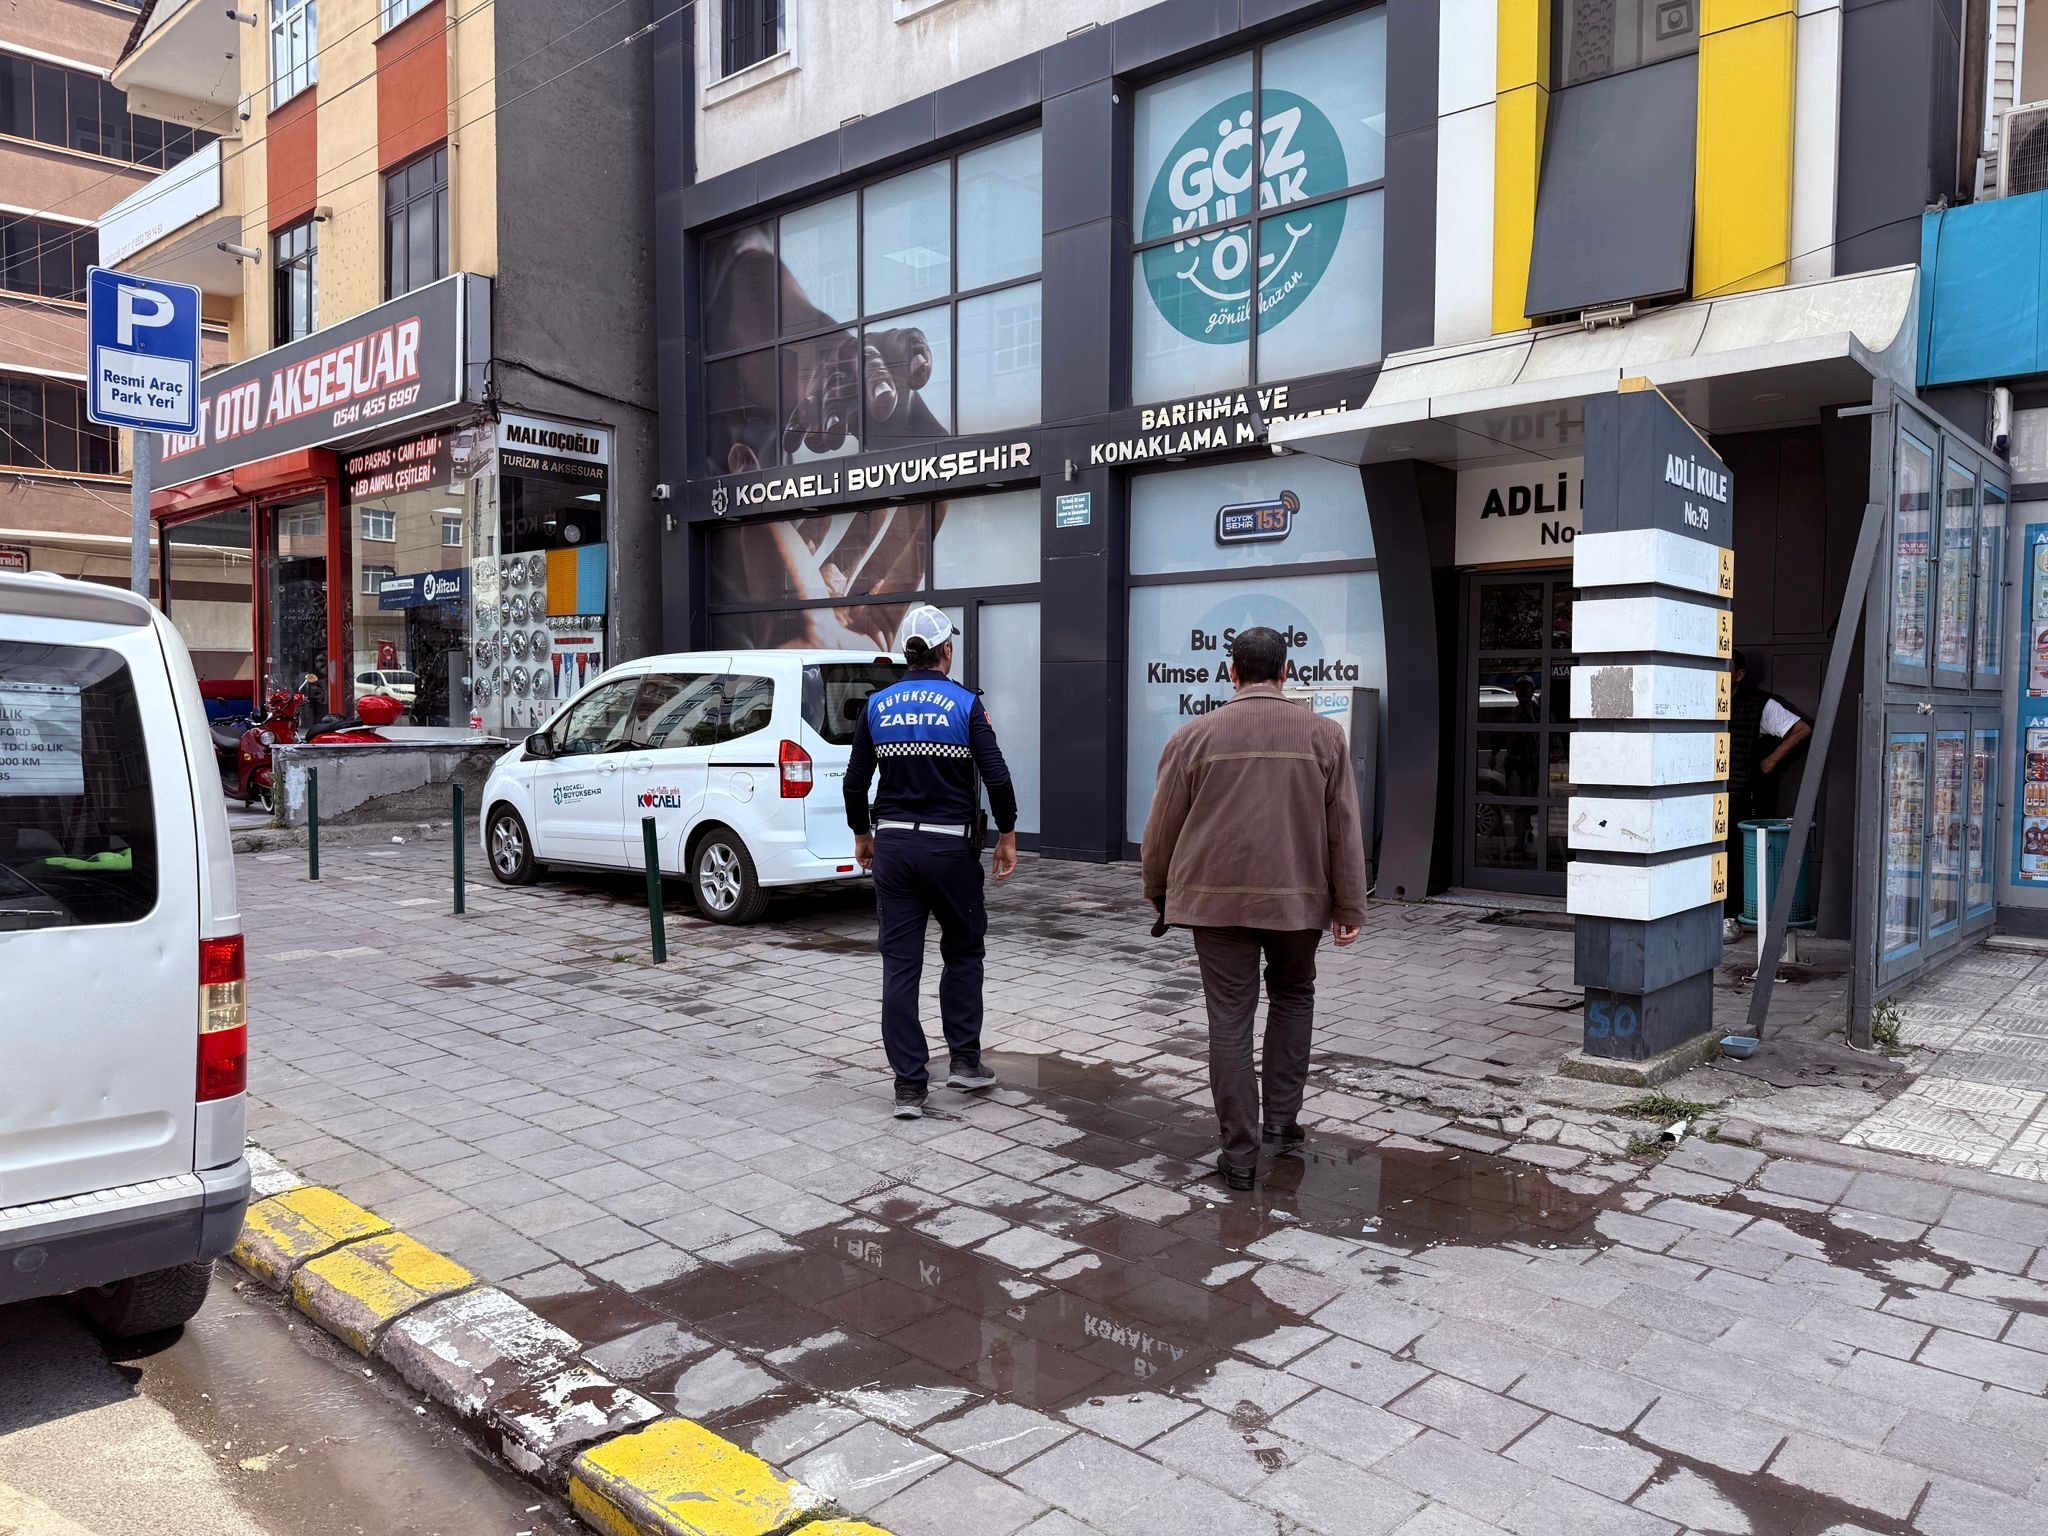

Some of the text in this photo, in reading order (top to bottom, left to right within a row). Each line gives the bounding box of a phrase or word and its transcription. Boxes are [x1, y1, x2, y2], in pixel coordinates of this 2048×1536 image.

[1168, 106, 1306, 211] GÖZ
[117, 283, 175, 346] P
[103, 369, 183, 397] Resmi Araç
[214, 380, 261, 442] OTO
[264, 318, 421, 427] AKSESUAR
[111, 388, 175, 409] Park Yeri
[333, 385, 421, 428] 0541 455 6997
[1141, 393, 1250, 431] BARINMA
[1256, 386, 1289, 411] VE
[506, 424, 600, 455] MALKOÇOĞLU
[1090, 426, 1228, 465] KONAKLAMA
[349, 433, 437, 475] OTO PASPAS CAM FİLMİ
[502, 454, 604, 479] TURİZM & AKSESUAR
[847, 442, 1033, 493] BÜYÜKŞEHİR
[355, 459, 431, 496] LED AMPUL ÇEŞİTLERİ
[1664, 453, 1728, 503] ADLİ KULE
[1480, 471, 1567, 519] ADLİ
[1225, 508, 1285, 530] BÜYÜK 153
[1225, 521, 1254, 531] ŞEHİR
[1684, 501, 1709, 531] No:79
[1722, 555, 1729, 571] 6.
[1720, 573, 1731, 590] Kat
[1721, 616, 1728, 633] 5.
[1191, 629, 1217, 651] Bu
[1718, 635, 1730, 652] Kat
[1147, 662, 1210, 684] Kimse
[1286, 658, 1359, 687] Açıkta
[1720, 678, 1727, 694] 4.
[876, 689, 956, 714] BÜYÜKŞEHİR
[1314, 692, 1350, 708] beko
[1717, 699, 1729, 713] Kat
[879, 713, 950, 728] ZABITA
[0, 728, 31, 737] FORD
[31, 743, 45, 752] 90
[1719, 739, 1725, 754] 3.
[22, 757, 40, 767] KM
[1716, 759, 1727, 774] Kat
[1717, 800, 1724, 816] 2.
[1714, 819, 1726, 834] Kat
[1716, 860, 1723, 875] 1.
[1713, 880, 1725, 895] Kat
